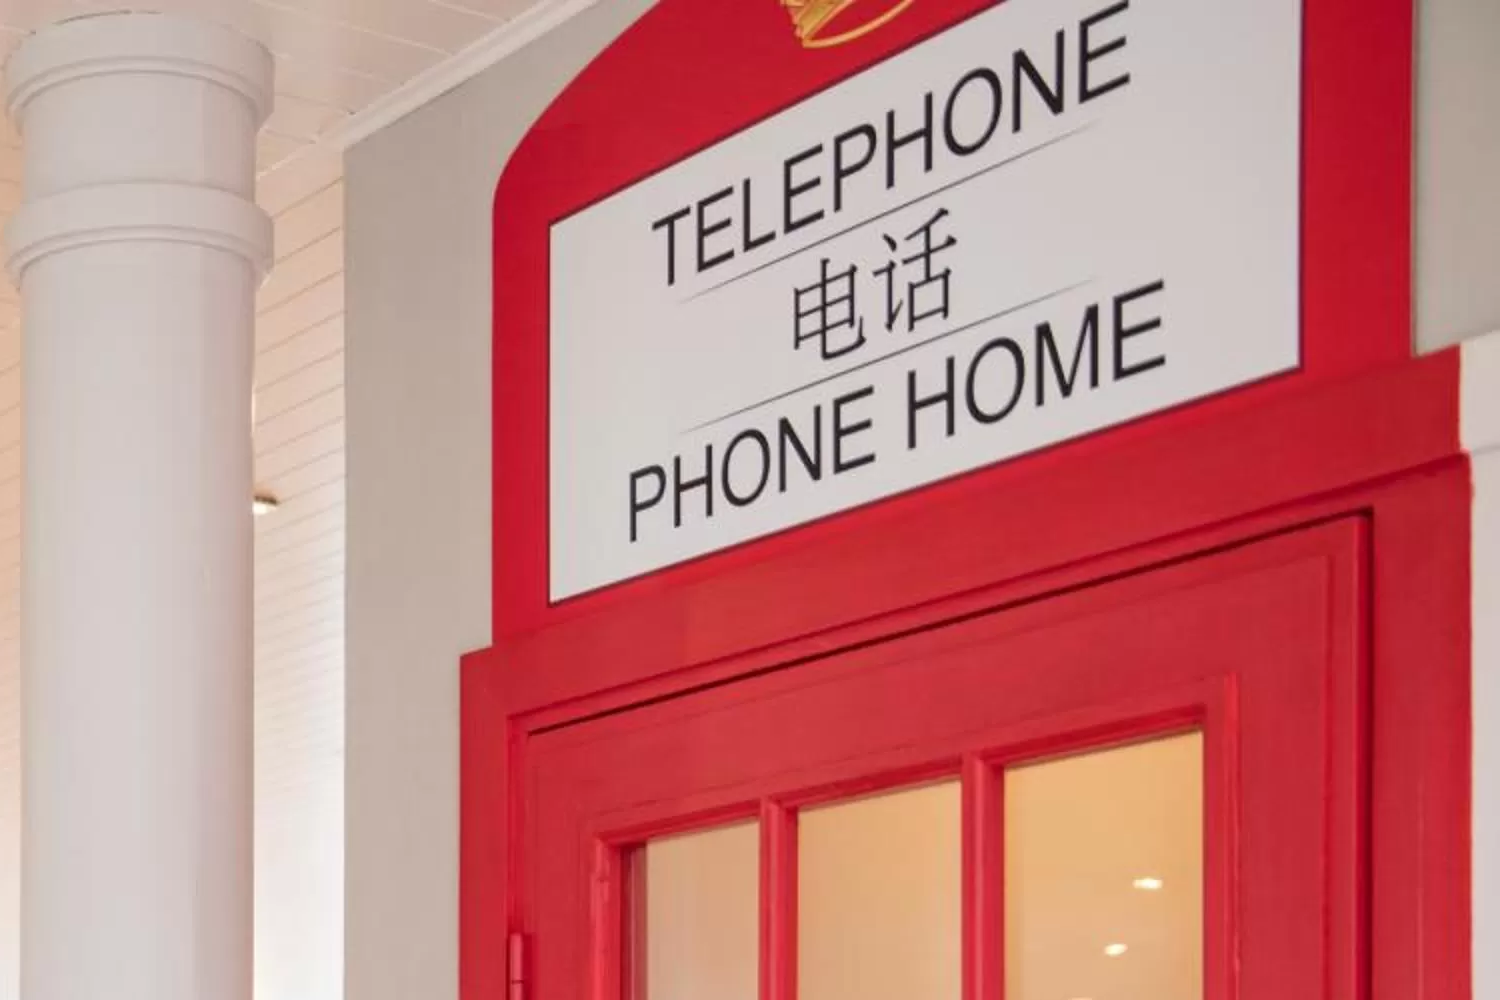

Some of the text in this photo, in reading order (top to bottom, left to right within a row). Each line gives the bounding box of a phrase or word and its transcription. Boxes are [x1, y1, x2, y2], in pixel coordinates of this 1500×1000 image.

[652, 0, 1131, 285] TELEPHONE
[630, 280, 1166, 543] PHONE HOME
[793, 207, 957, 361] 电话
